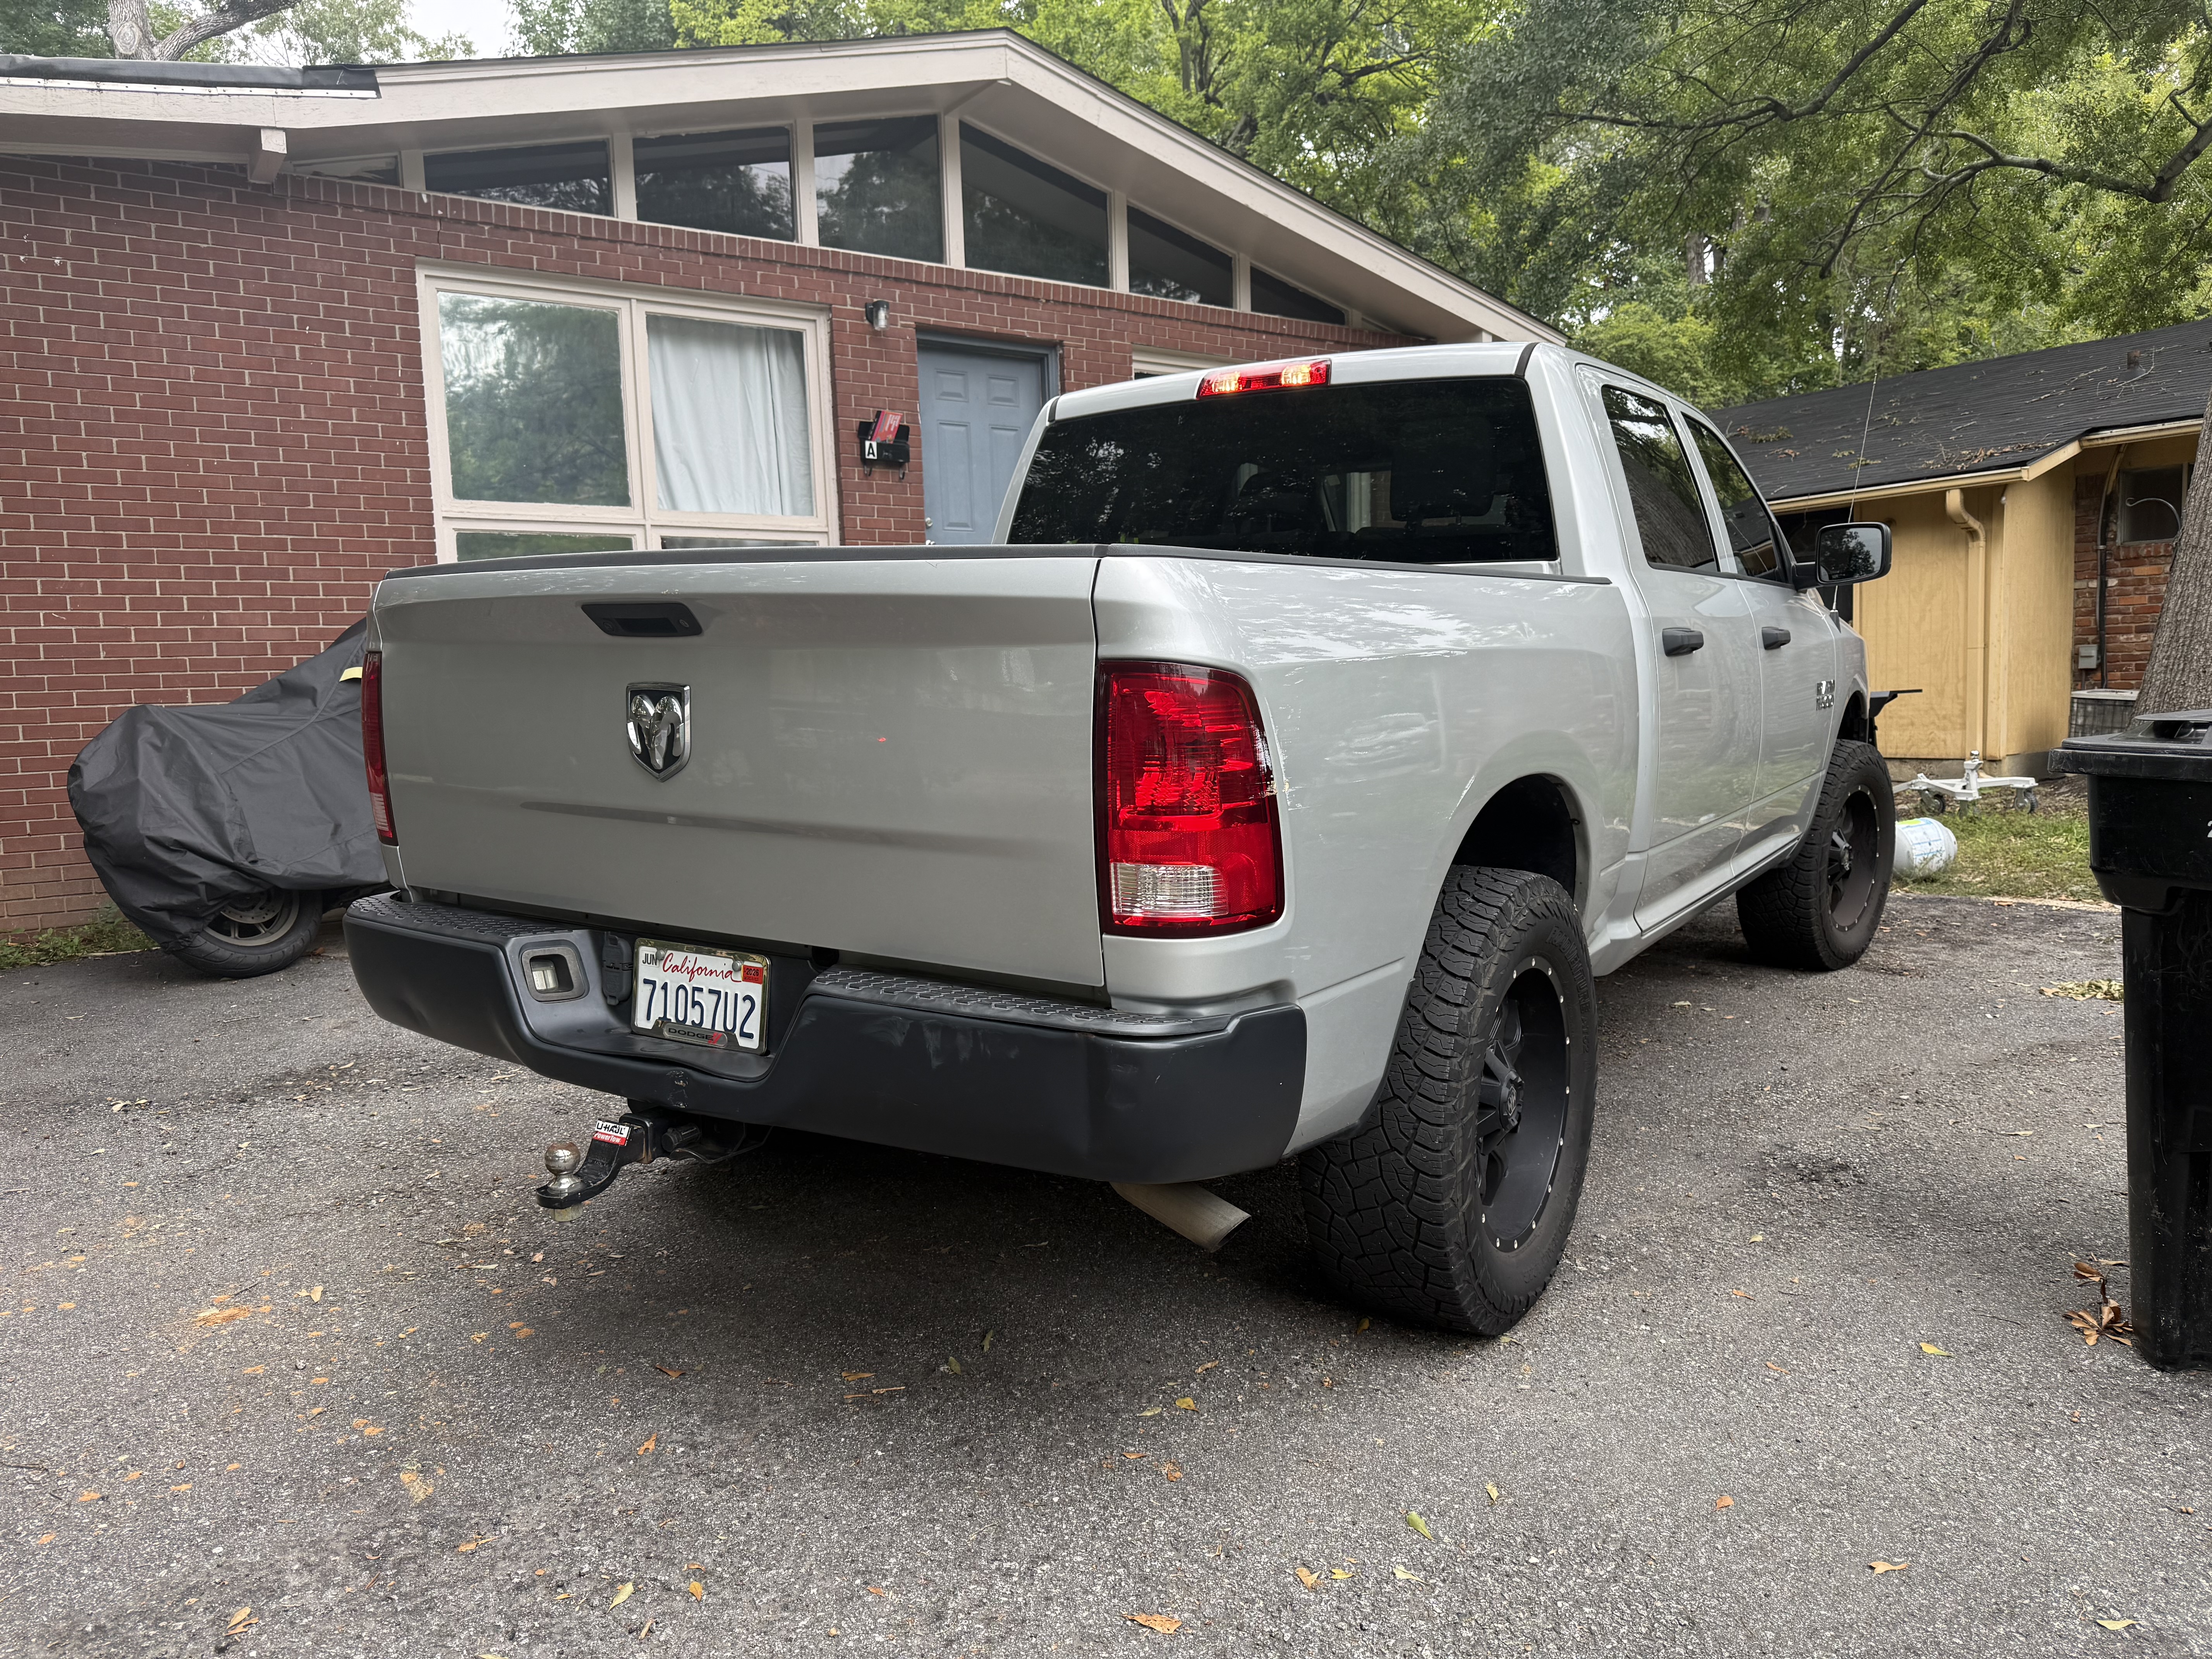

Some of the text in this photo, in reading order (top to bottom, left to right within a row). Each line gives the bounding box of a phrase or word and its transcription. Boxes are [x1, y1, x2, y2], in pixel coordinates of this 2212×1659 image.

[867, 443, 875, 457] A
[642, 953, 657, 966] JUN
[663, 953, 742, 982] California
[746, 968, 759, 976] 2026
[643, 978, 756, 1039] 71057U2
[668, 1028, 714, 1041] DODGE
[596, 1122, 623, 1135] U-HAUL
